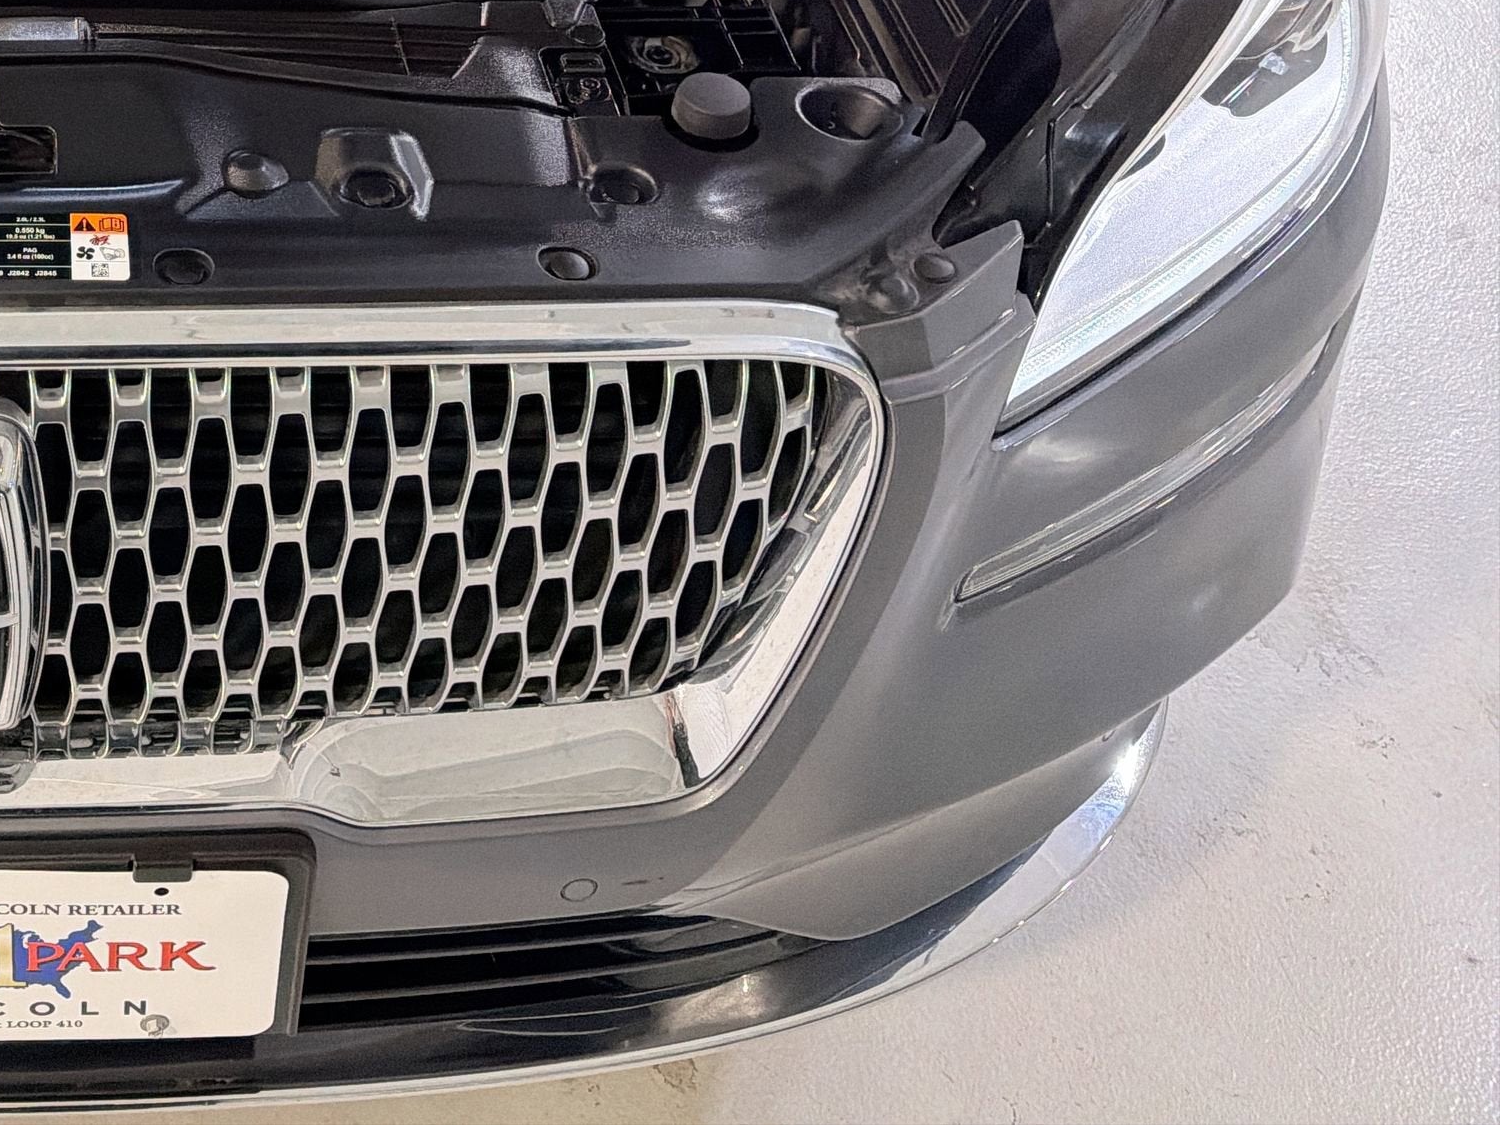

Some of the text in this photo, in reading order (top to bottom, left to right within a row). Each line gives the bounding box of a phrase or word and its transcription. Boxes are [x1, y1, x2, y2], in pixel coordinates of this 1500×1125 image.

[67, 904, 183, 916] RETAILER
[26, 941, 217, 972] PARK
[7, 1020, 53, 1028] LOOP
